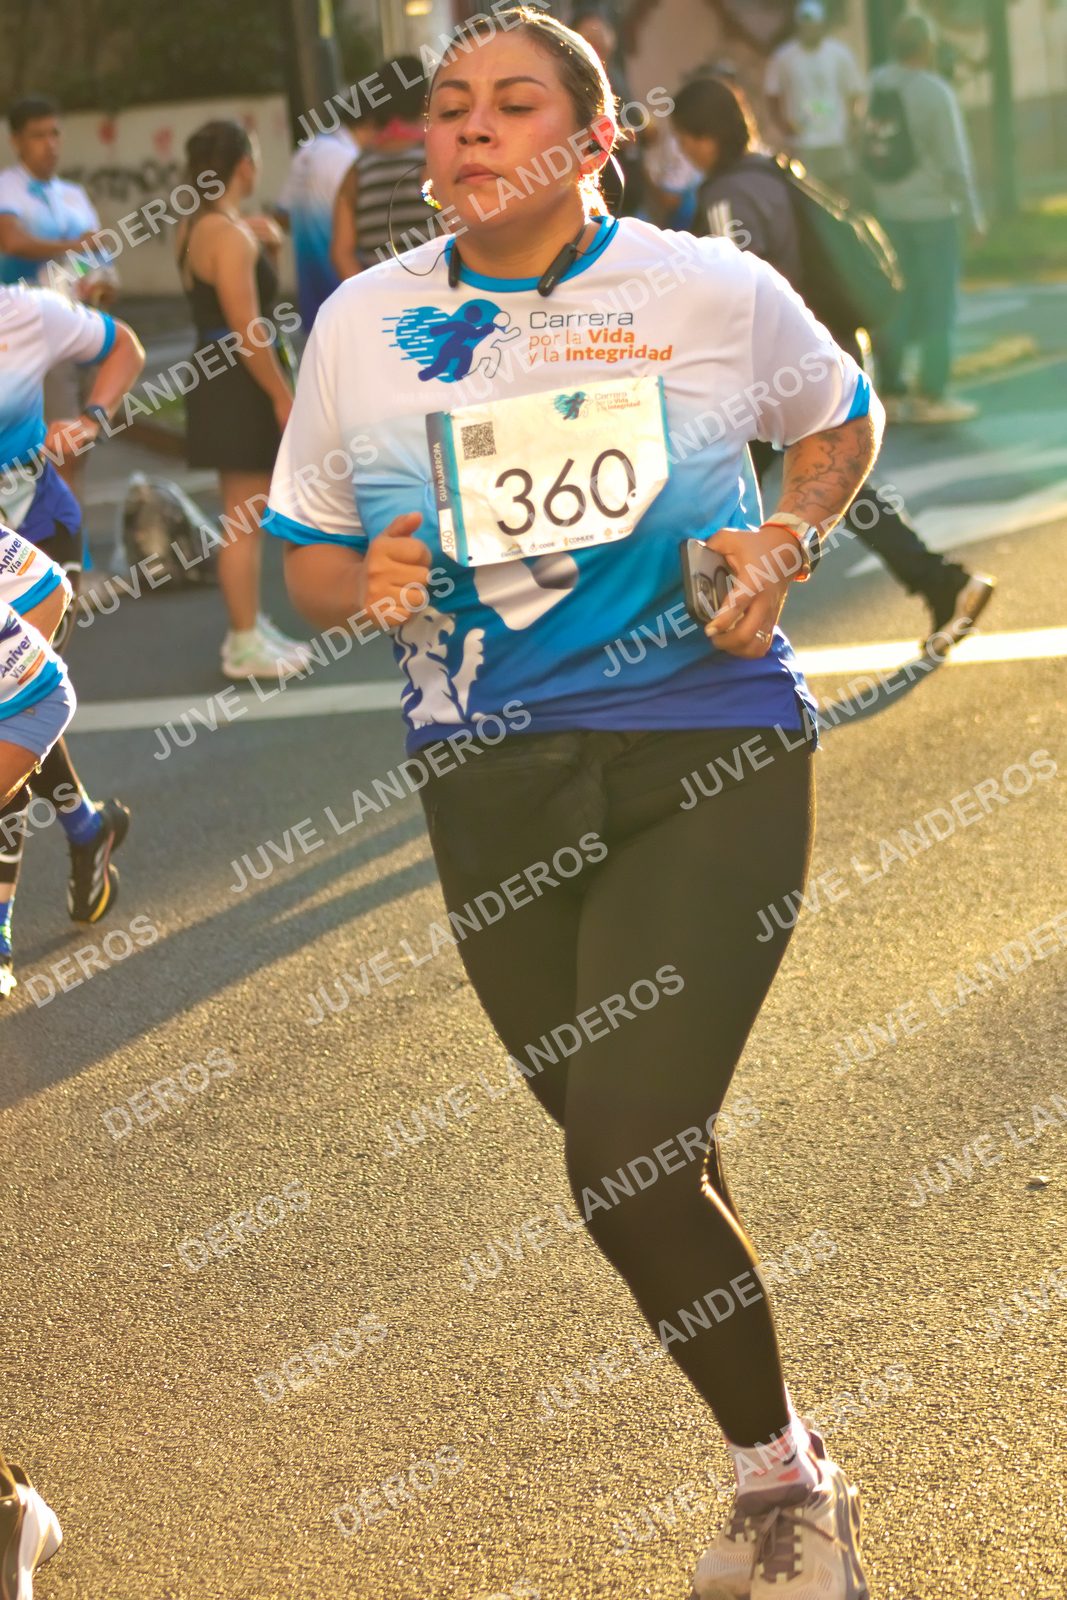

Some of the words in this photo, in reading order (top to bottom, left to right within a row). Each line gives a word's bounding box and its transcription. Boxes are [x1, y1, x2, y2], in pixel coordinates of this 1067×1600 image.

[529, 311, 634, 329] Carrera
[529, 334, 560, 350] por
[565, 330, 581, 345] la
[588, 328, 635, 344] Vida
[529, 351, 538, 366] y
[543, 347, 559, 362] la
[565, 343, 673, 364] Integridad
[495, 449, 636, 536] 360
